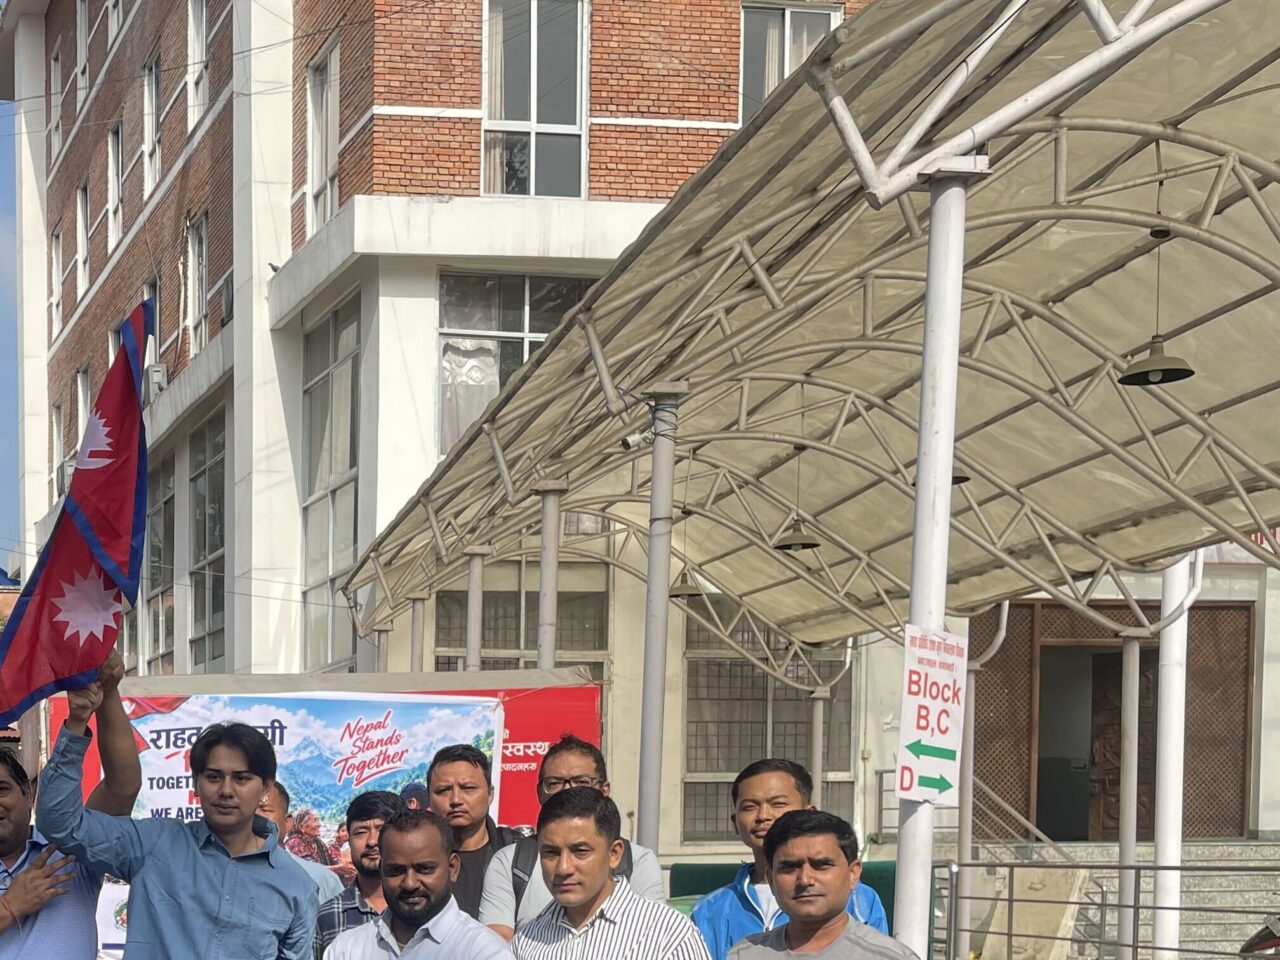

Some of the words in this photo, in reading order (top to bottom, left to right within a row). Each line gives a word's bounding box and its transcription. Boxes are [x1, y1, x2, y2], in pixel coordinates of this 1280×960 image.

[907, 669, 961, 705] Block
[340, 710, 392, 742] Nepal
[915, 704, 950, 737] B,C
[351, 729, 405, 755] Stands
[333, 748, 409, 783] Together
[899, 765, 914, 792] D
[147, 776, 194, 790] TOGET
[150, 808, 172, 820] WE
[176, 807, 202, 820] ARE
